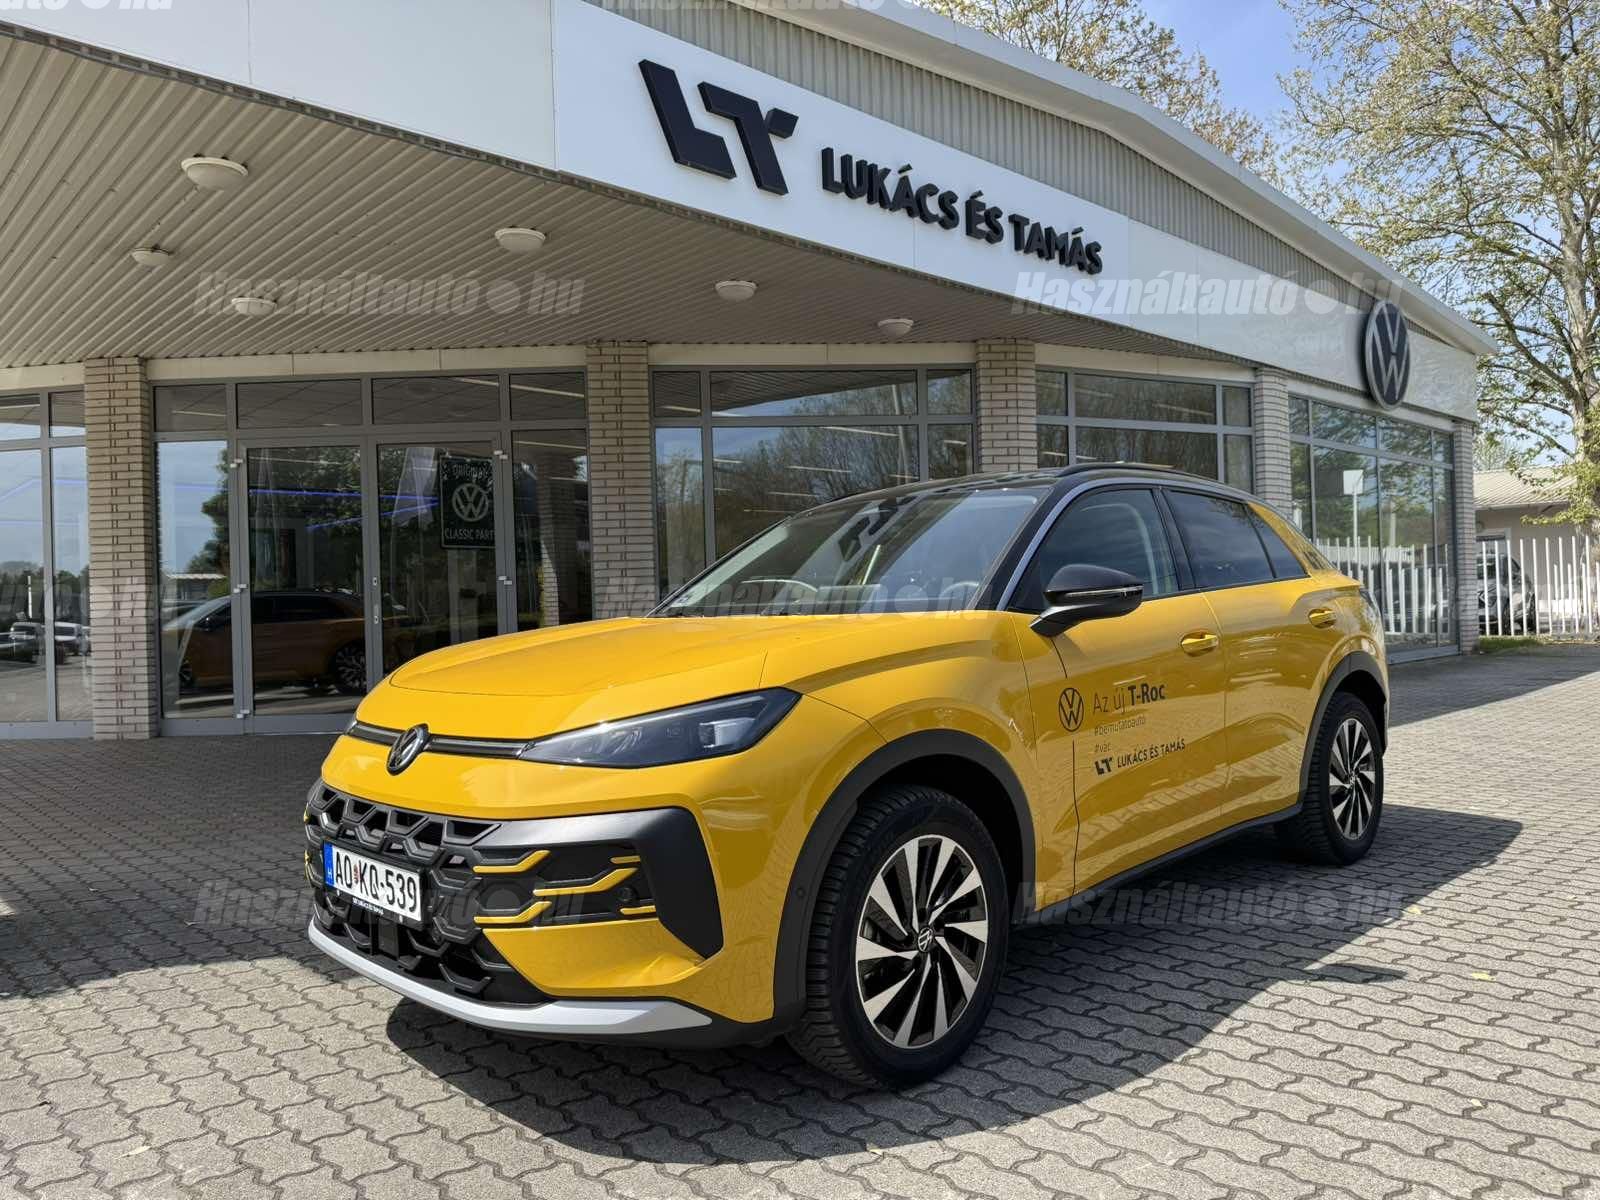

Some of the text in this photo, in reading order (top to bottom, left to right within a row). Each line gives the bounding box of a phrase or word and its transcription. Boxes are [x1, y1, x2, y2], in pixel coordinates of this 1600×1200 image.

[638, 58, 799, 196] LT
[821, 147, 1103, 275] LUKÁCS ÉS TAMÁS
[475, 529, 495, 540] PART
[1092, 682, 1166, 715] Az új T-Roc
[1117, 748, 1148, 769] LUKÁCS
[1149, 743, 1160, 760] ÉS
[1160, 737, 1186, 758] TAMÁS
[358, 860, 417, 913] KQ-539
